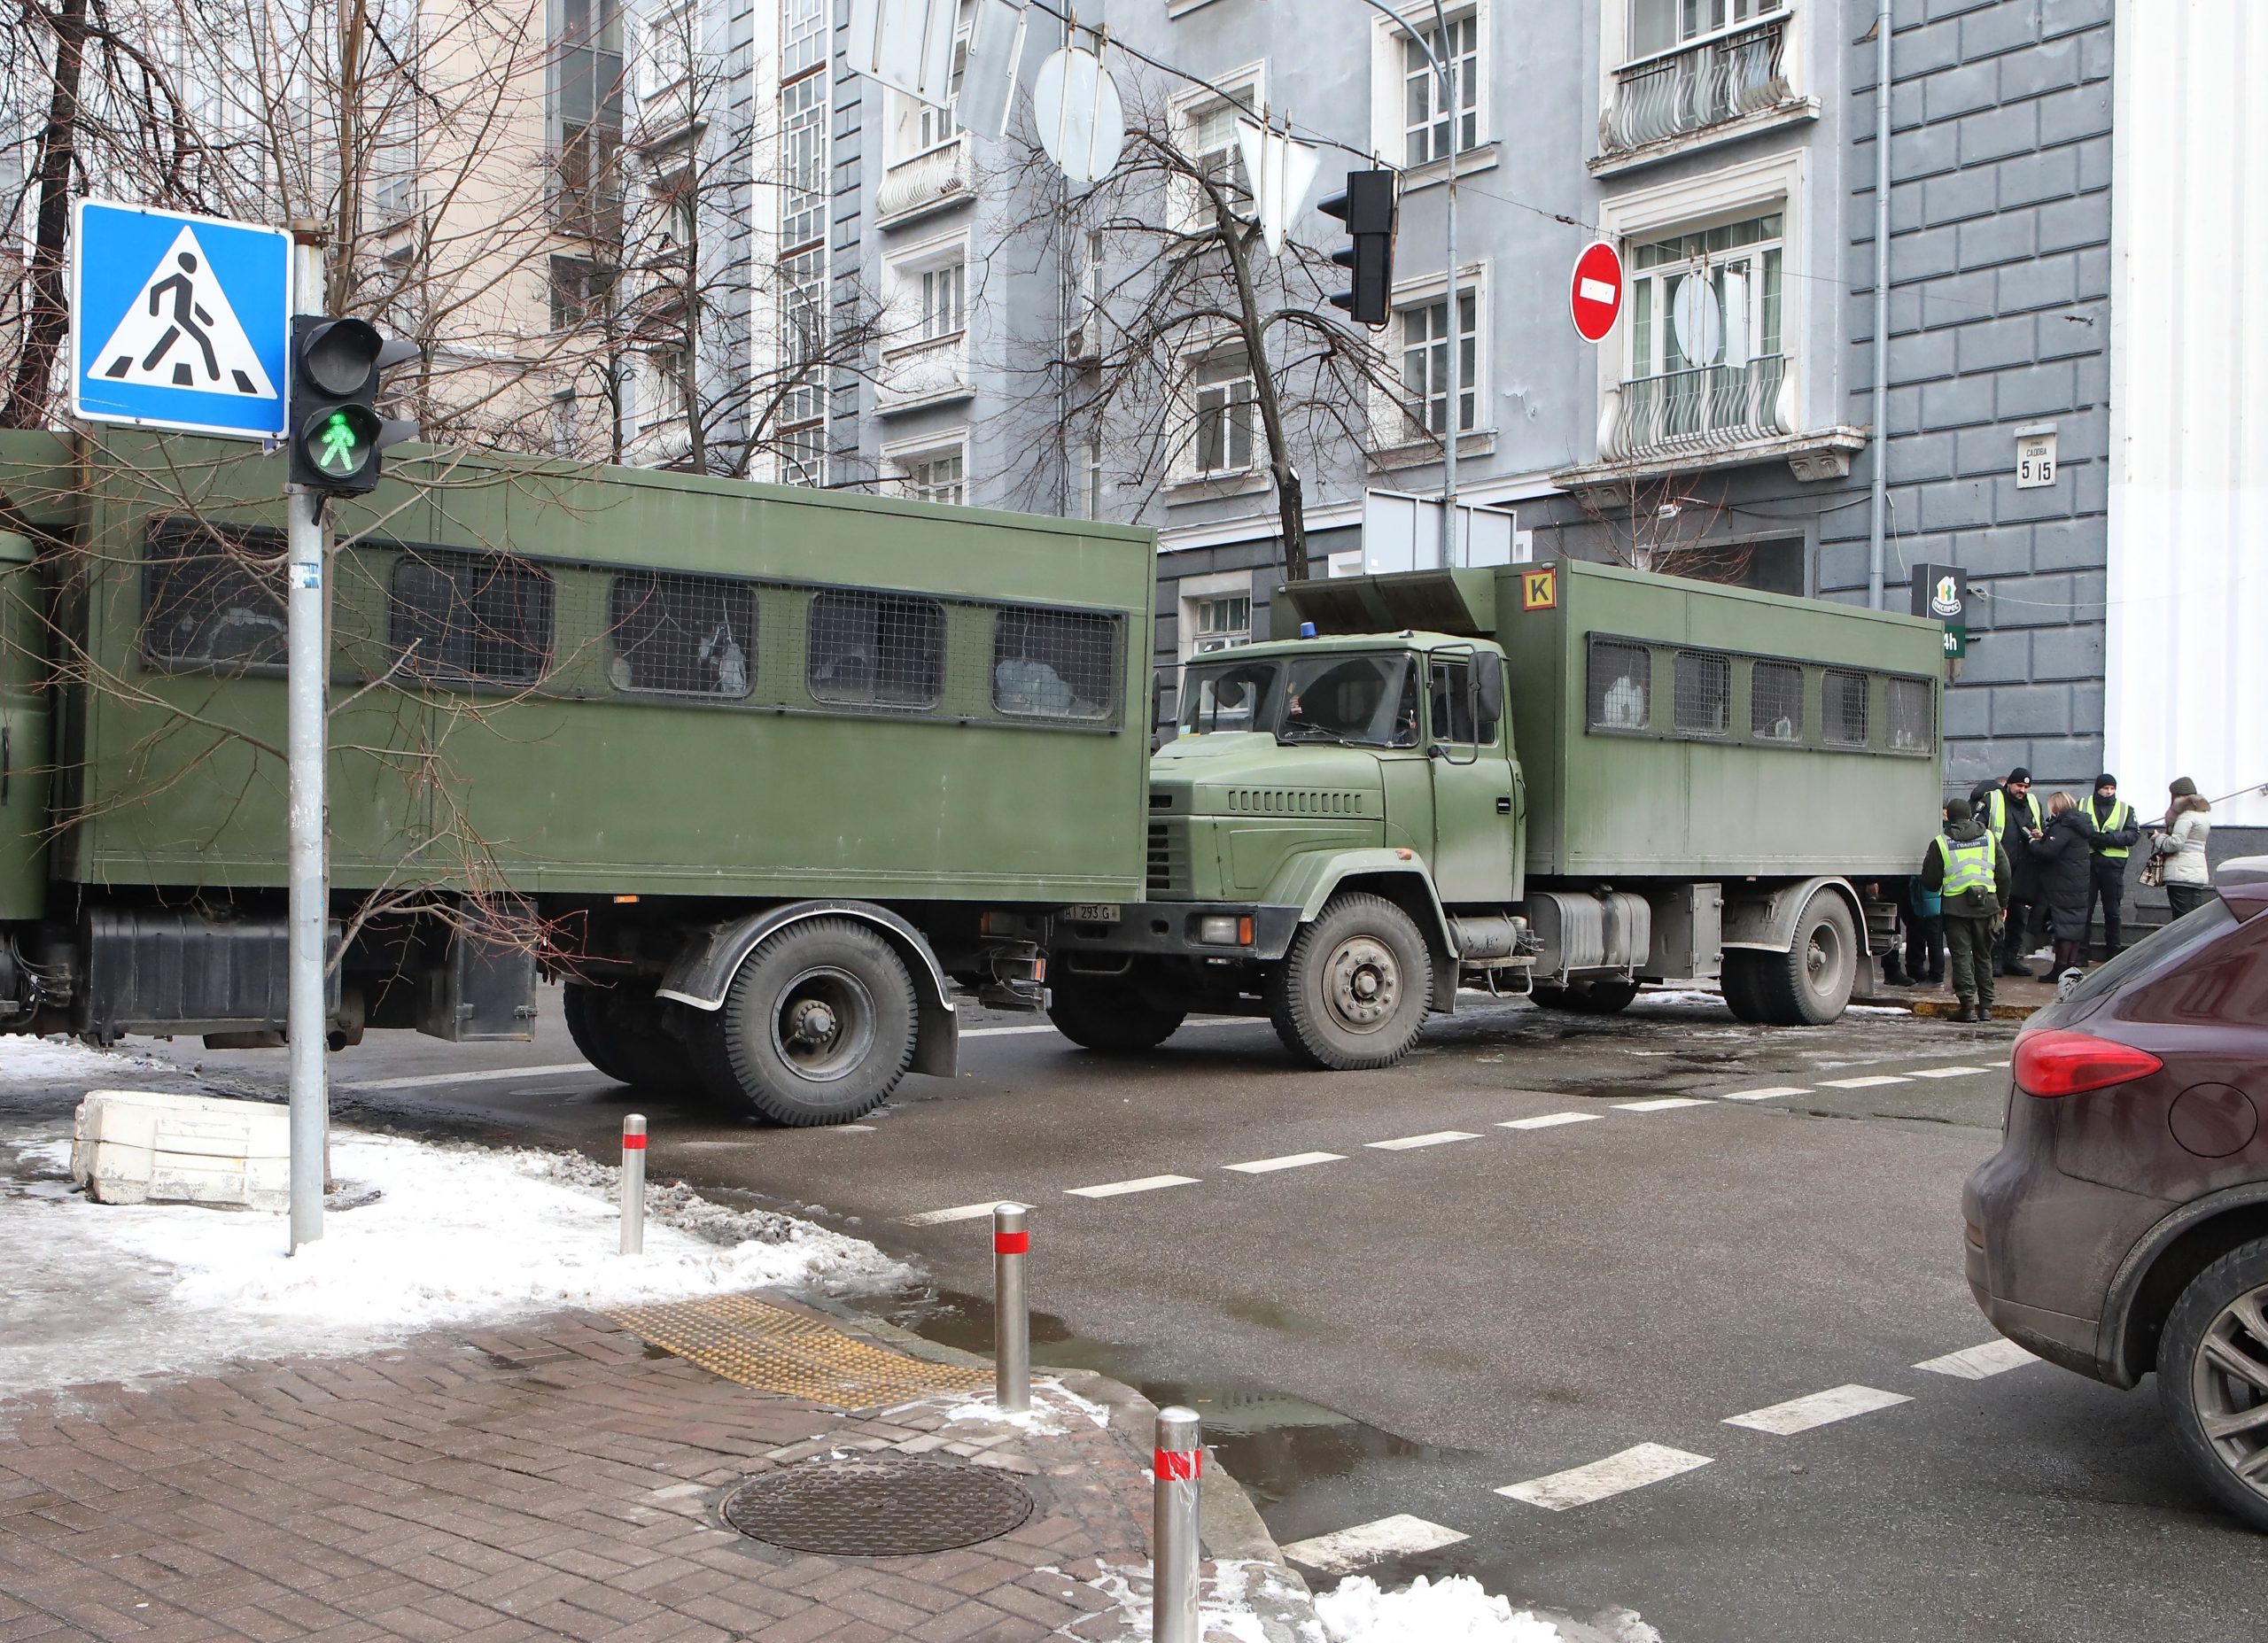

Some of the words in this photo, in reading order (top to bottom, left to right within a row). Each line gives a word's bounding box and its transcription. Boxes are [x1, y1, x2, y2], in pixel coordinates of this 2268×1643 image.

[2026, 447, 2047, 457] САДОВА
[1943, 632, 1957, 651] 4h
[1081, 906, 1099, 919] 293
